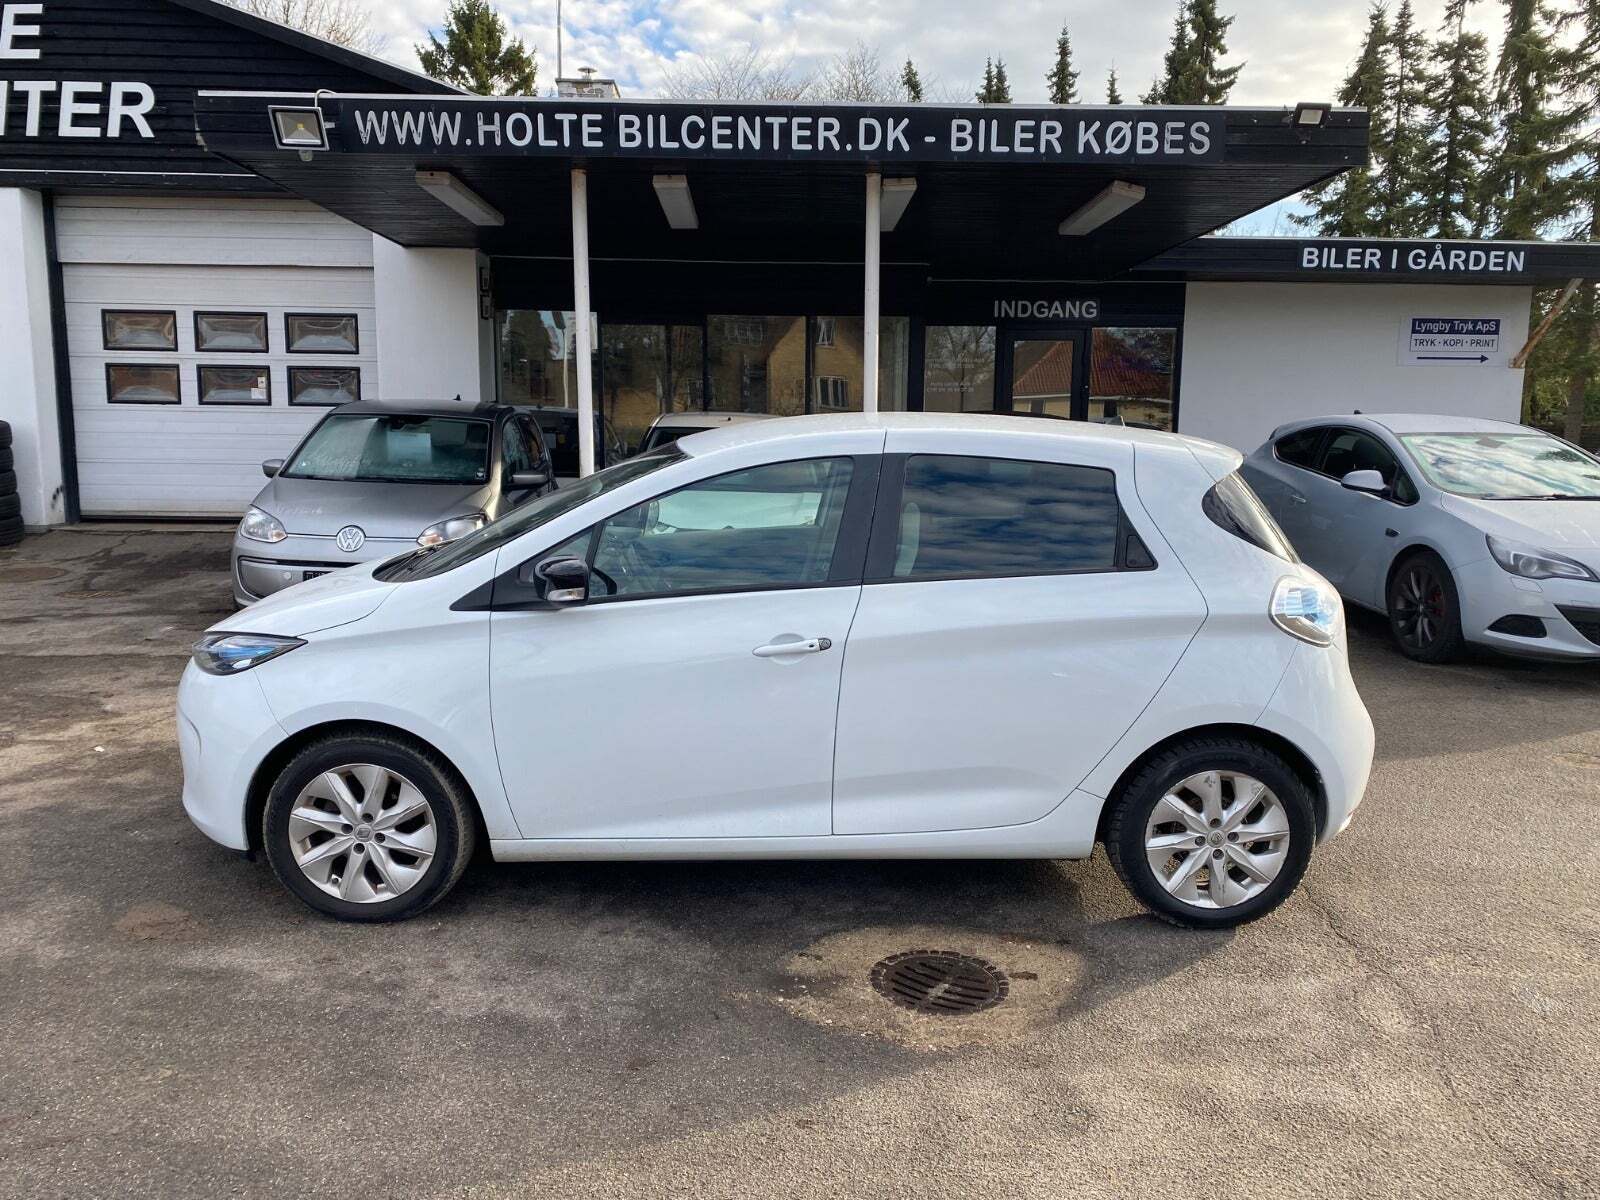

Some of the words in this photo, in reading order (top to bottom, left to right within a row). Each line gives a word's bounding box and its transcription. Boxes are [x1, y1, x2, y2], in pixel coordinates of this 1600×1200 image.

[0, 80, 156, 138] TER
[354, 110, 604, 148] WWW.HOLTE
[618, 114, 910, 152] BILCENTER.DK
[950, 118, 1063, 154] BILER
[1078, 120, 1212, 155] KØBES
[1302, 247, 1382, 269] BILER
[1391, 249, 1398, 269] I
[1408, 244, 1526, 272] GÅRDEN
[994, 300, 1098, 318] INDGANG
[1415, 320, 1450, 333] Lyngby
[1453, 321, 1474, 333] Tryk
[1475, 321, 1496, 333] ApS
[1414, 338, 1437, 347] TRYK
[1443, 339, 1464, 347] KOPI
[1470, 339, 1495, 348] PRINT
